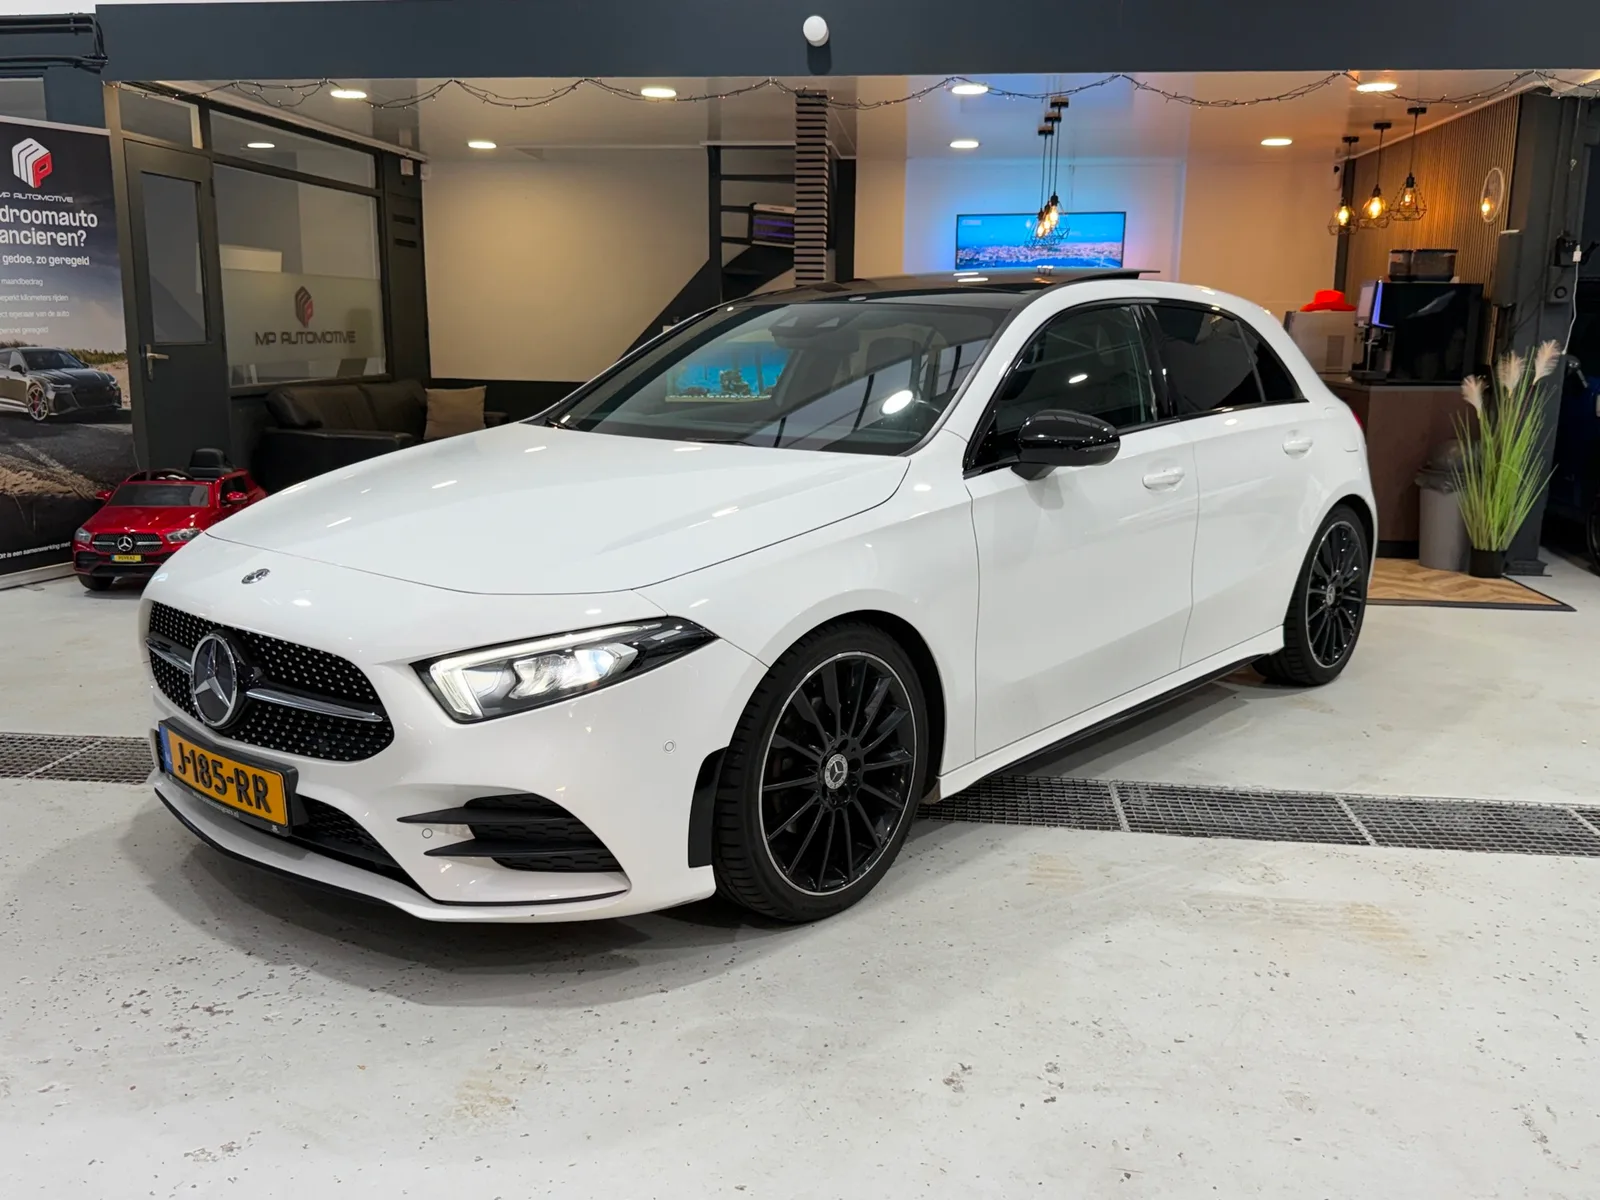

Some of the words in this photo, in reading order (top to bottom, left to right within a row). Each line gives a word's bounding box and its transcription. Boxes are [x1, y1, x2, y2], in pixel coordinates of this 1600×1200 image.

[13, 192, 73, 203] AUTOMOTIVE
[0, 205, 98, 228] droomauto
[0, 227, 87, 247] ancieren?
[36, 256, 47, 264] zo
[48, 256, 90, 267] geregeld
[1, 277, 44, 287] maandbedrag
[52, 294, 69, 303] rijden
[255, 331, 277, 346] MP
[280, 330, 357, 345] AUTOMOTIVE
[23, 544, 61, 555] samenwerking
[177, 742, 272, 814] J-185-RR
